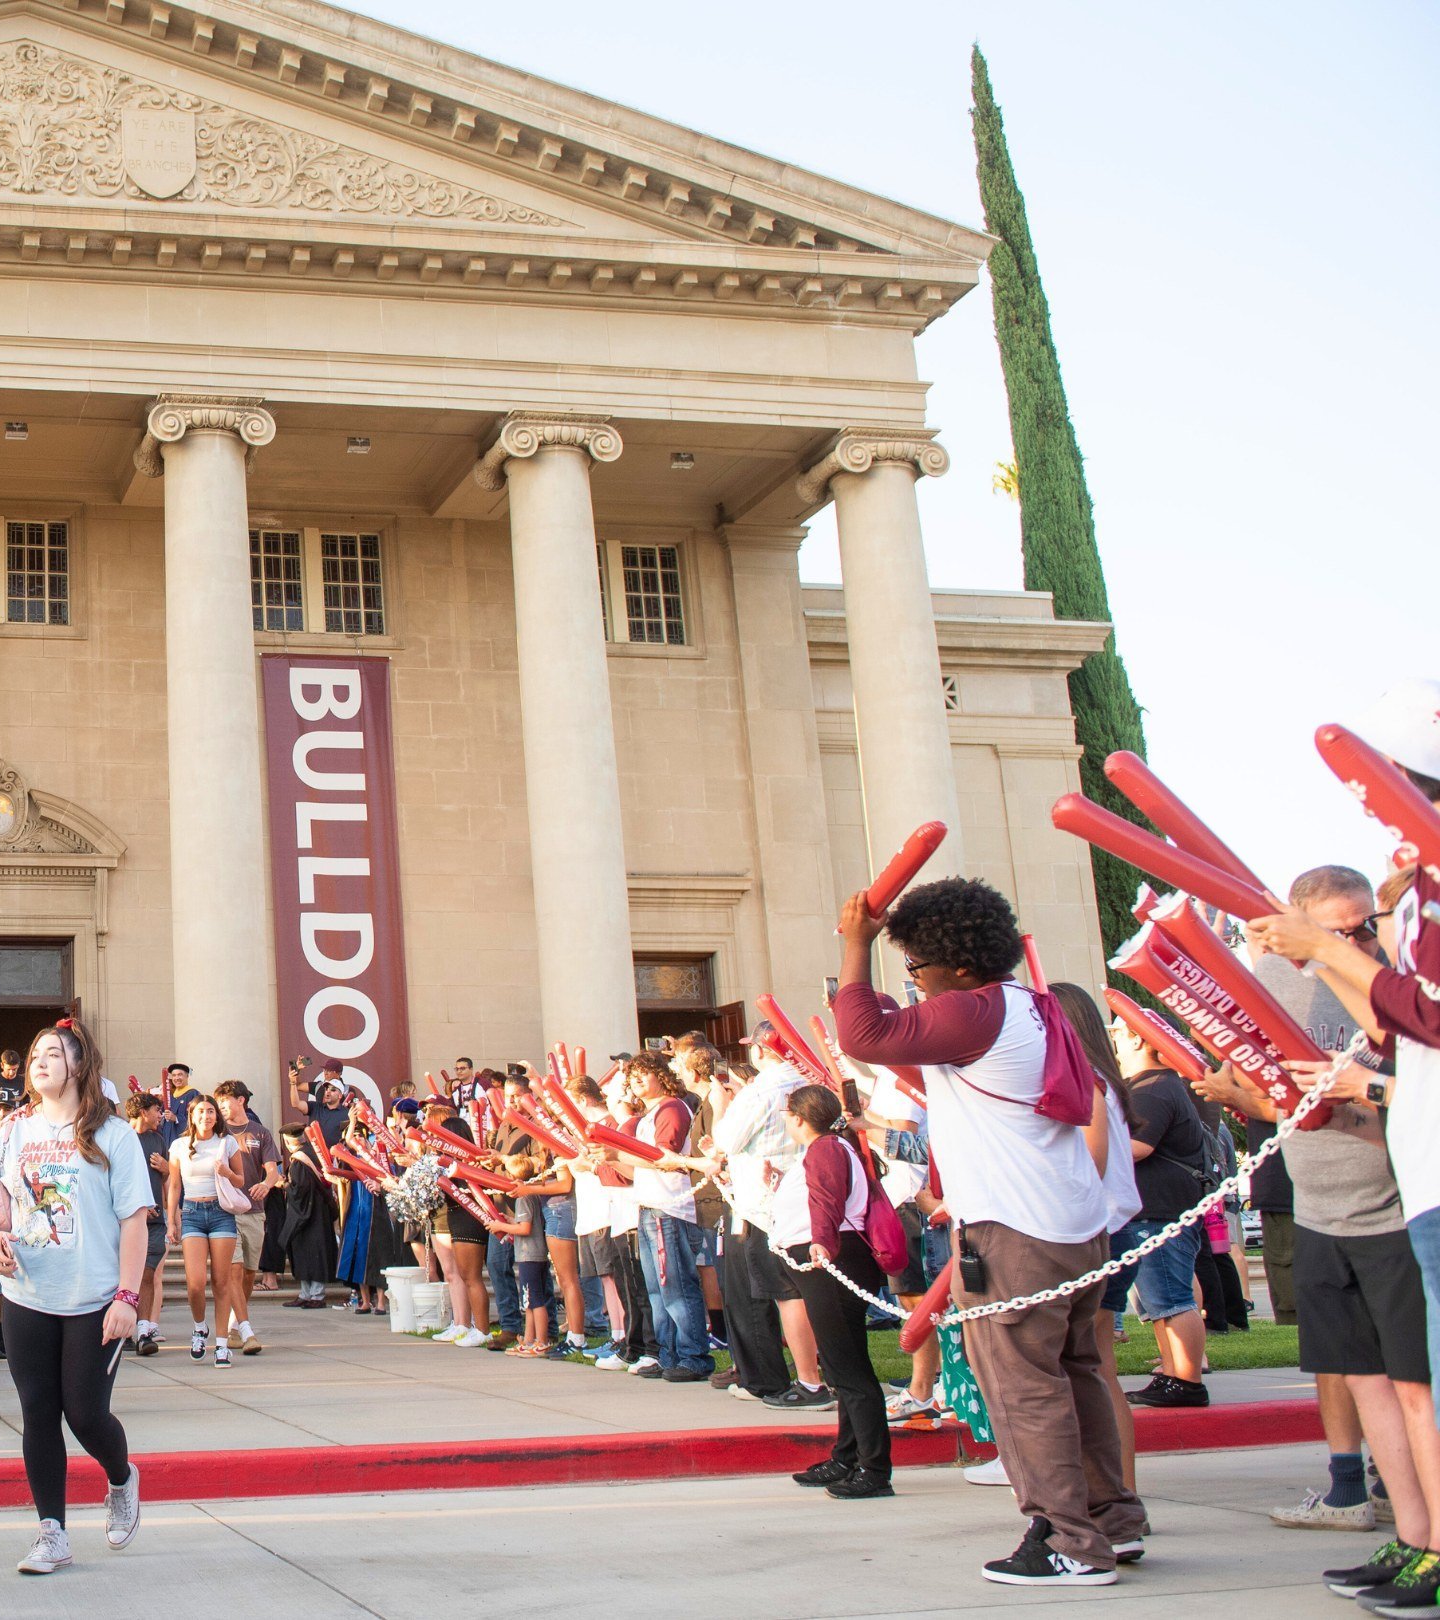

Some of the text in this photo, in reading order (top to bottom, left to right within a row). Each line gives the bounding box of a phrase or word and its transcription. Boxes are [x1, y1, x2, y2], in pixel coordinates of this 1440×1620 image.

[160, 120, 187, 133] ARE
[136, 139, 179, 153] THE
[128, 159, 193, 173] BRANCHES
[1156, 983, 1238, 1048] DAWGS!
[1228, 1043, 1266, 1072] GO
[22, 1140, 78, 1153] AMAZING
[432, 1139, 470, 1159] GO DAWGS!
[18, 1152, 74, 1163] FANTASY
[457, 1193, 469, 1205] GO
